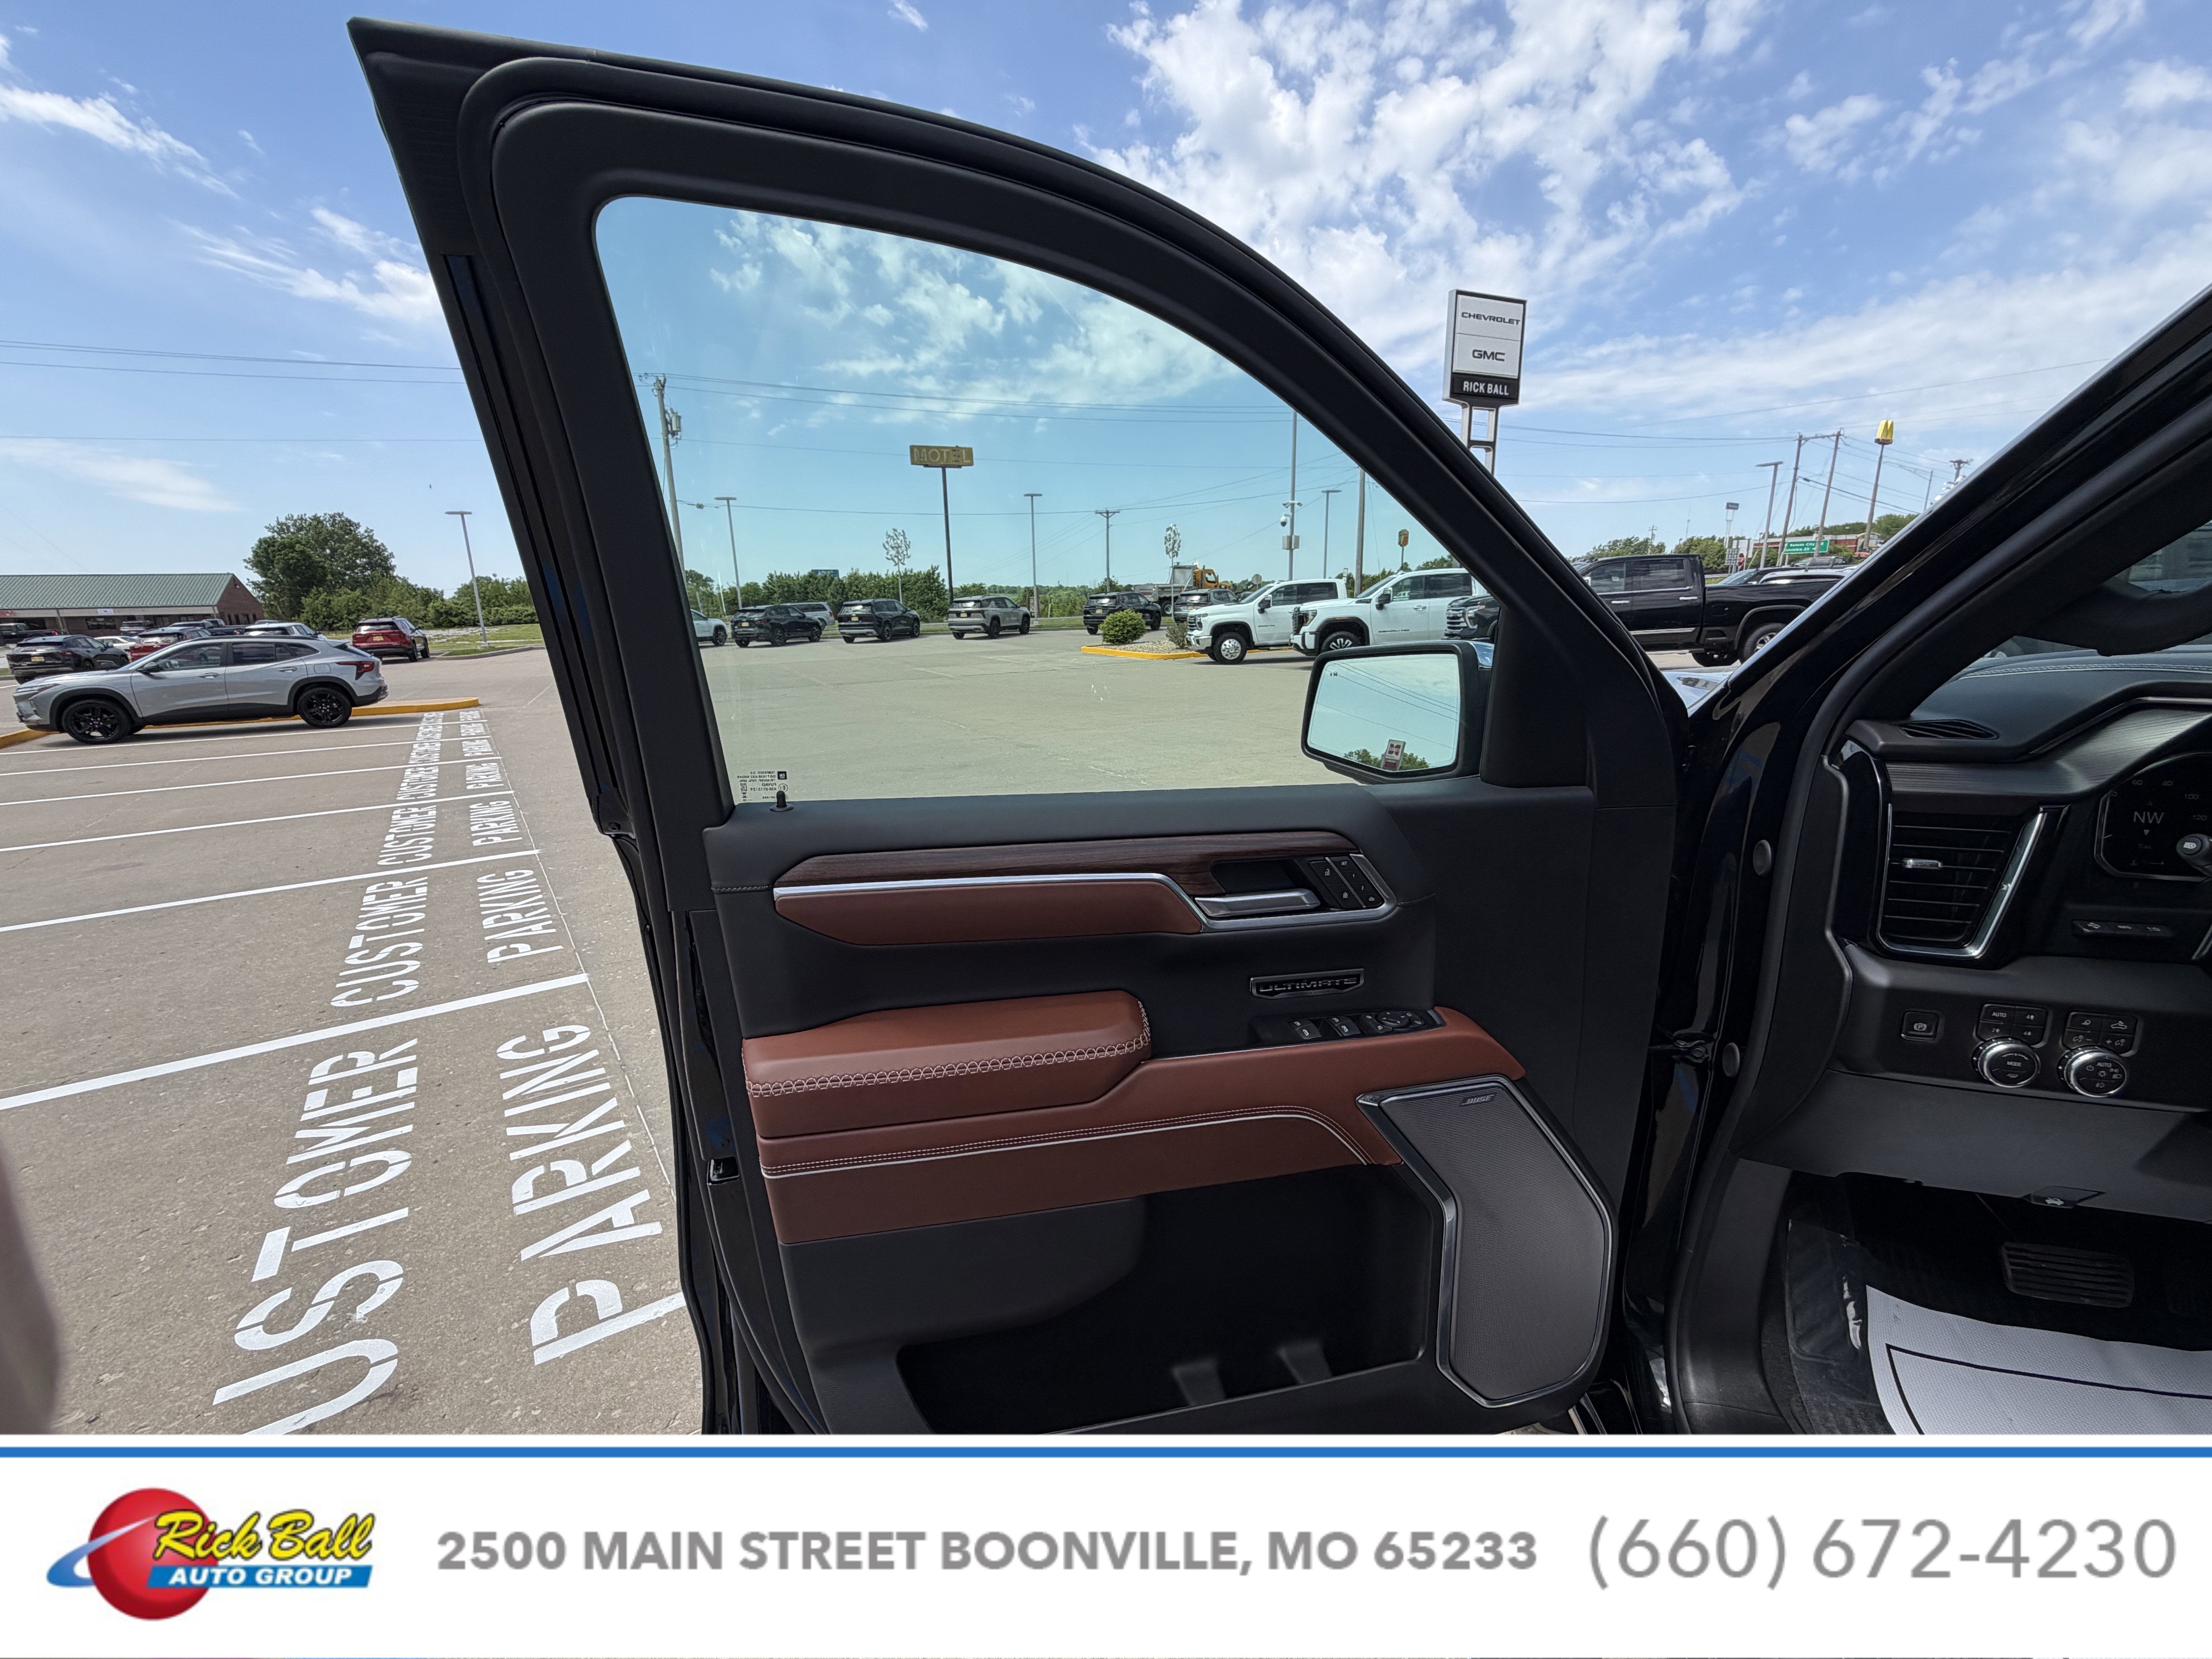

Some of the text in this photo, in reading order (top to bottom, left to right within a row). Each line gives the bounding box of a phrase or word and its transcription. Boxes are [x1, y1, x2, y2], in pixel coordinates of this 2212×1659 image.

[1461, 312, 1520, 325] CHEVROLET
[1472, 349, 1506, 362] GMC
[1463, 381, 1509, 396] RICK BALL
[396, 766, 439, 800] CUSTOMER
[466, 762, 503, 789] PARKING
[469, 801, 522, 847] PARKING
[2133, 811, 2165, 824] NW
[378, 804, 436, 866] CUSTOMER
[476, 869, 564, 963] PARKING
[330, 876, 428, 1008] CUSTOMER
[1259, 977, 1357, 992] ULTIMATE
[496, 1024, 688, 1365] PARKING
[213, 1038, 418, 1436] USTOMER
